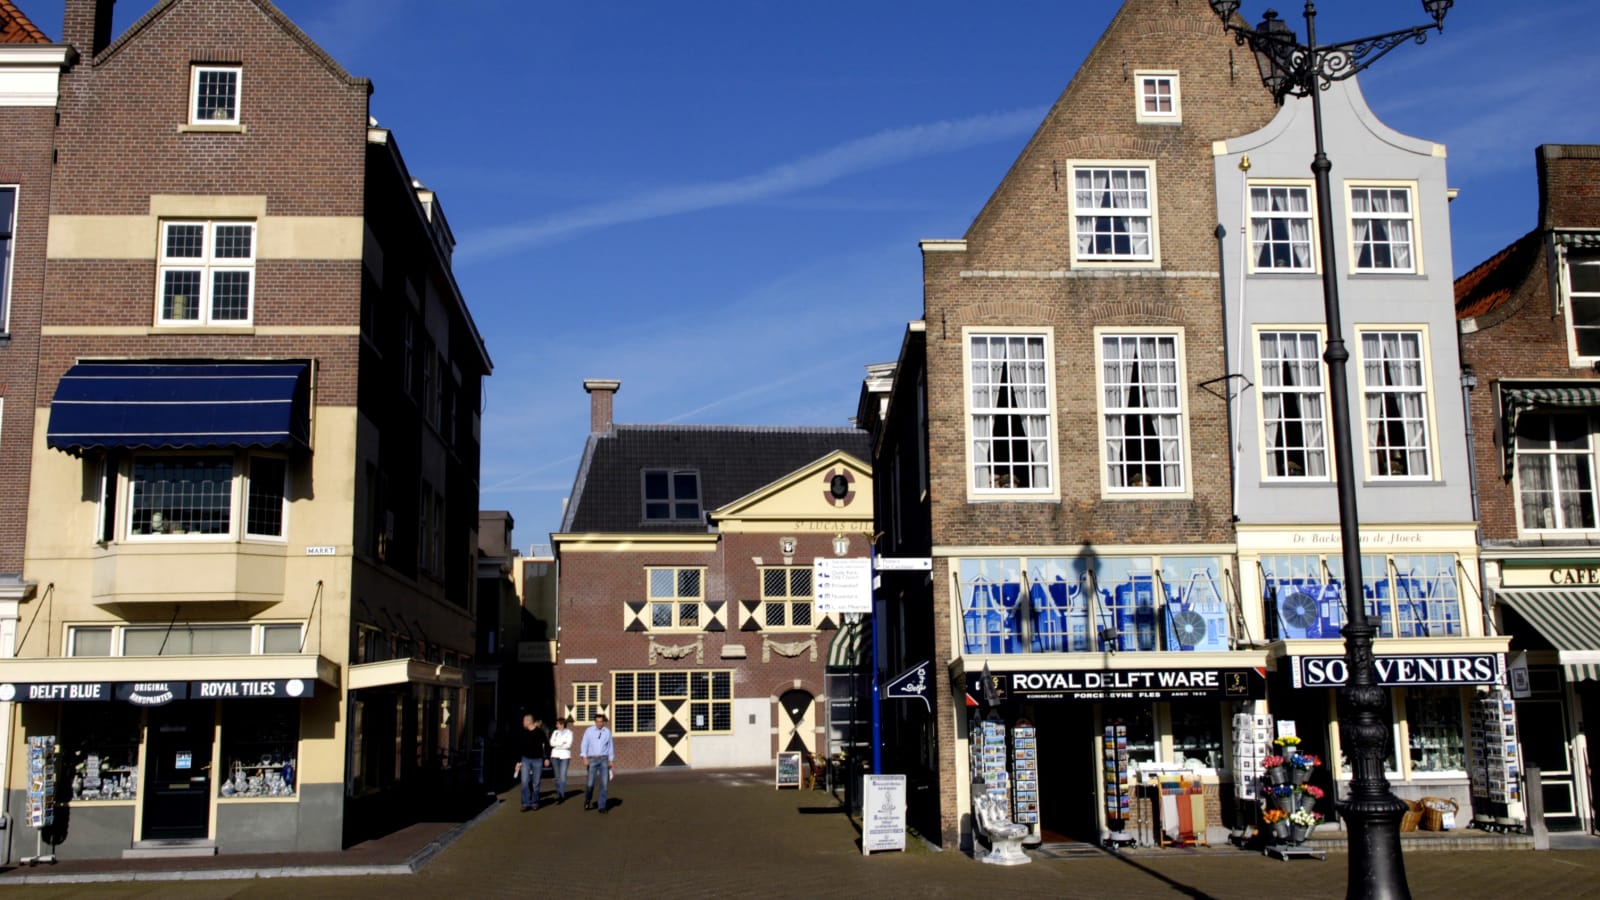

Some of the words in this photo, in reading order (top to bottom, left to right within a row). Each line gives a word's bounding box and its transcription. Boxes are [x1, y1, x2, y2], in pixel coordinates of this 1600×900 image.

[809, 522, 845, 530] LUCAS
[850, 522, 874, 531] GIL
[1293, 533, 1305, 543] De
[1373, 533, 1385, 543] de
[1550, 568, 1600, 584] CAFE
[1307, 656, 1492, 684] SOVENIRS
[134, 683, 169, 692] ORIGINAL
[1013, 673, 1082, 689] ROYAL
[1085, 672, 1155, 688] DELFT
[1158, 671, 1219, 687] WARE
[29, 684, 68, 699] DELFT
[69, 684, 101, 698] BLUE
[200, 682, 239, 697] ROYAL
[241, 682, 276, 696] TILES
[129, 691, 174, 705] HANDPAINTED
